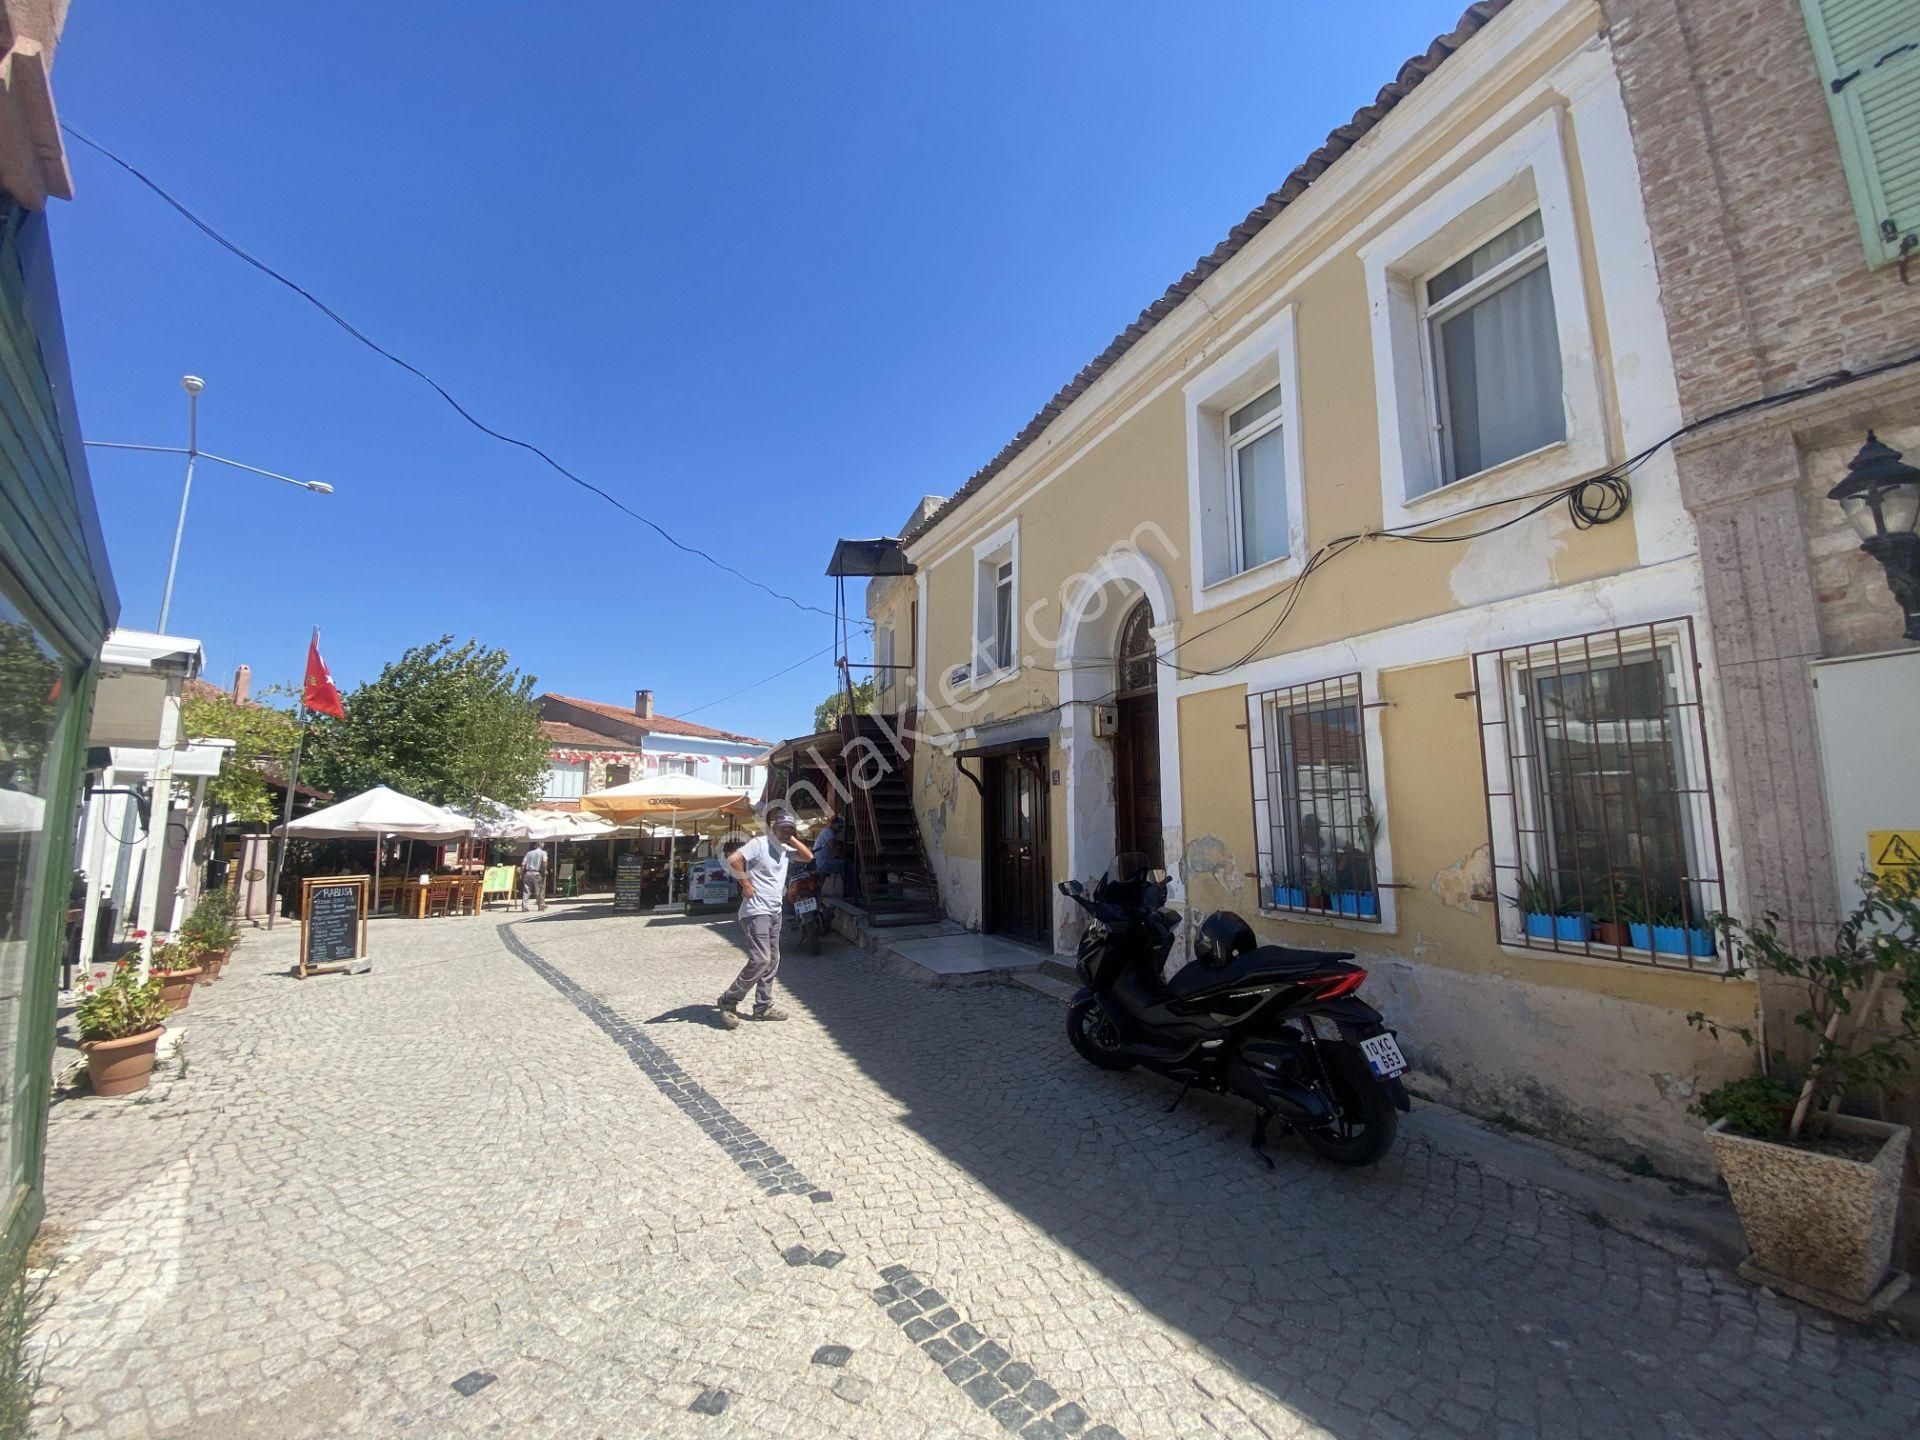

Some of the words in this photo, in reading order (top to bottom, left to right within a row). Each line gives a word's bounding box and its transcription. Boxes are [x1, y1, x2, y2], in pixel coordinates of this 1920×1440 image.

[1365, 1042, 1379, 1057] 10
[1377, 1037, 1392, 1052] KC
[1381, 1052, 1401, 1069] 653
